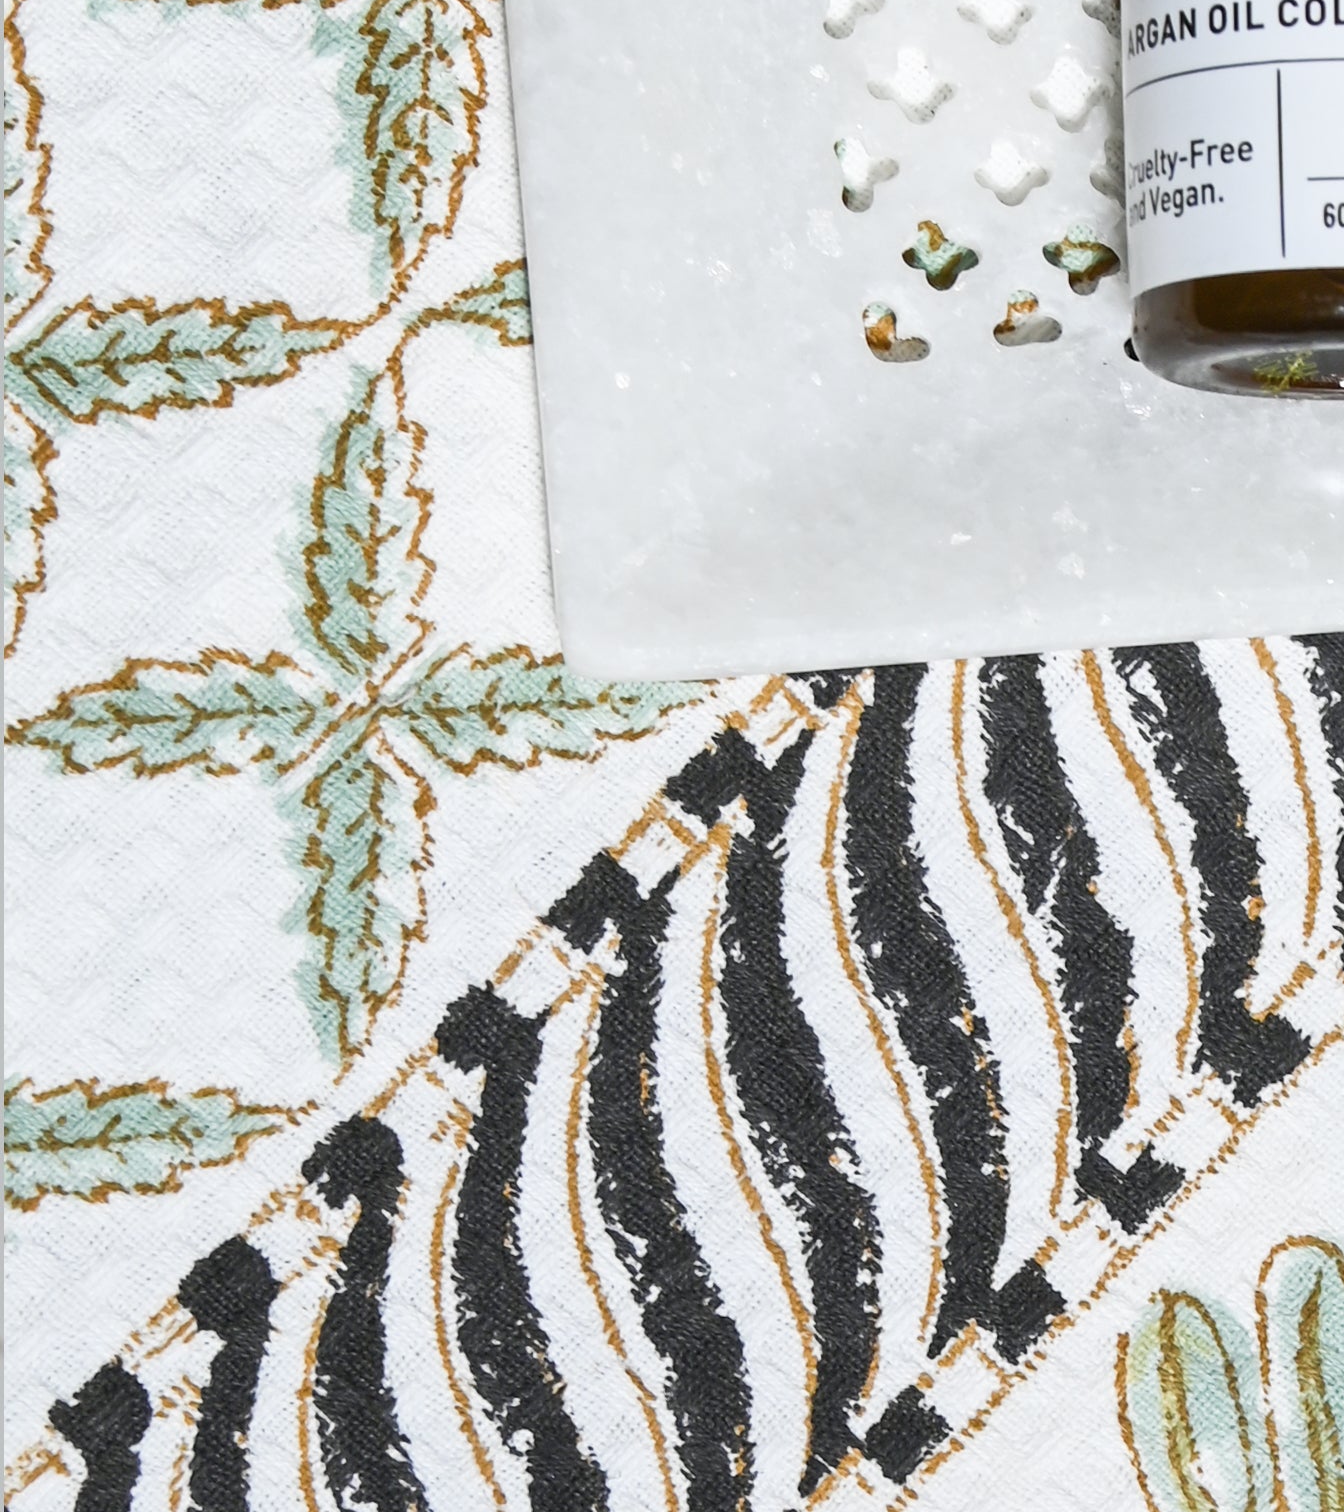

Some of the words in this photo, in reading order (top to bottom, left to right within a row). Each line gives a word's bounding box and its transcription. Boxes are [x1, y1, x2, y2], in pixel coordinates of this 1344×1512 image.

[1127, 7, 1197, 60] ARGAN
[1208, 0, 1264, 35] OIL
[1149, 183, 1224, 218] Vegan.
